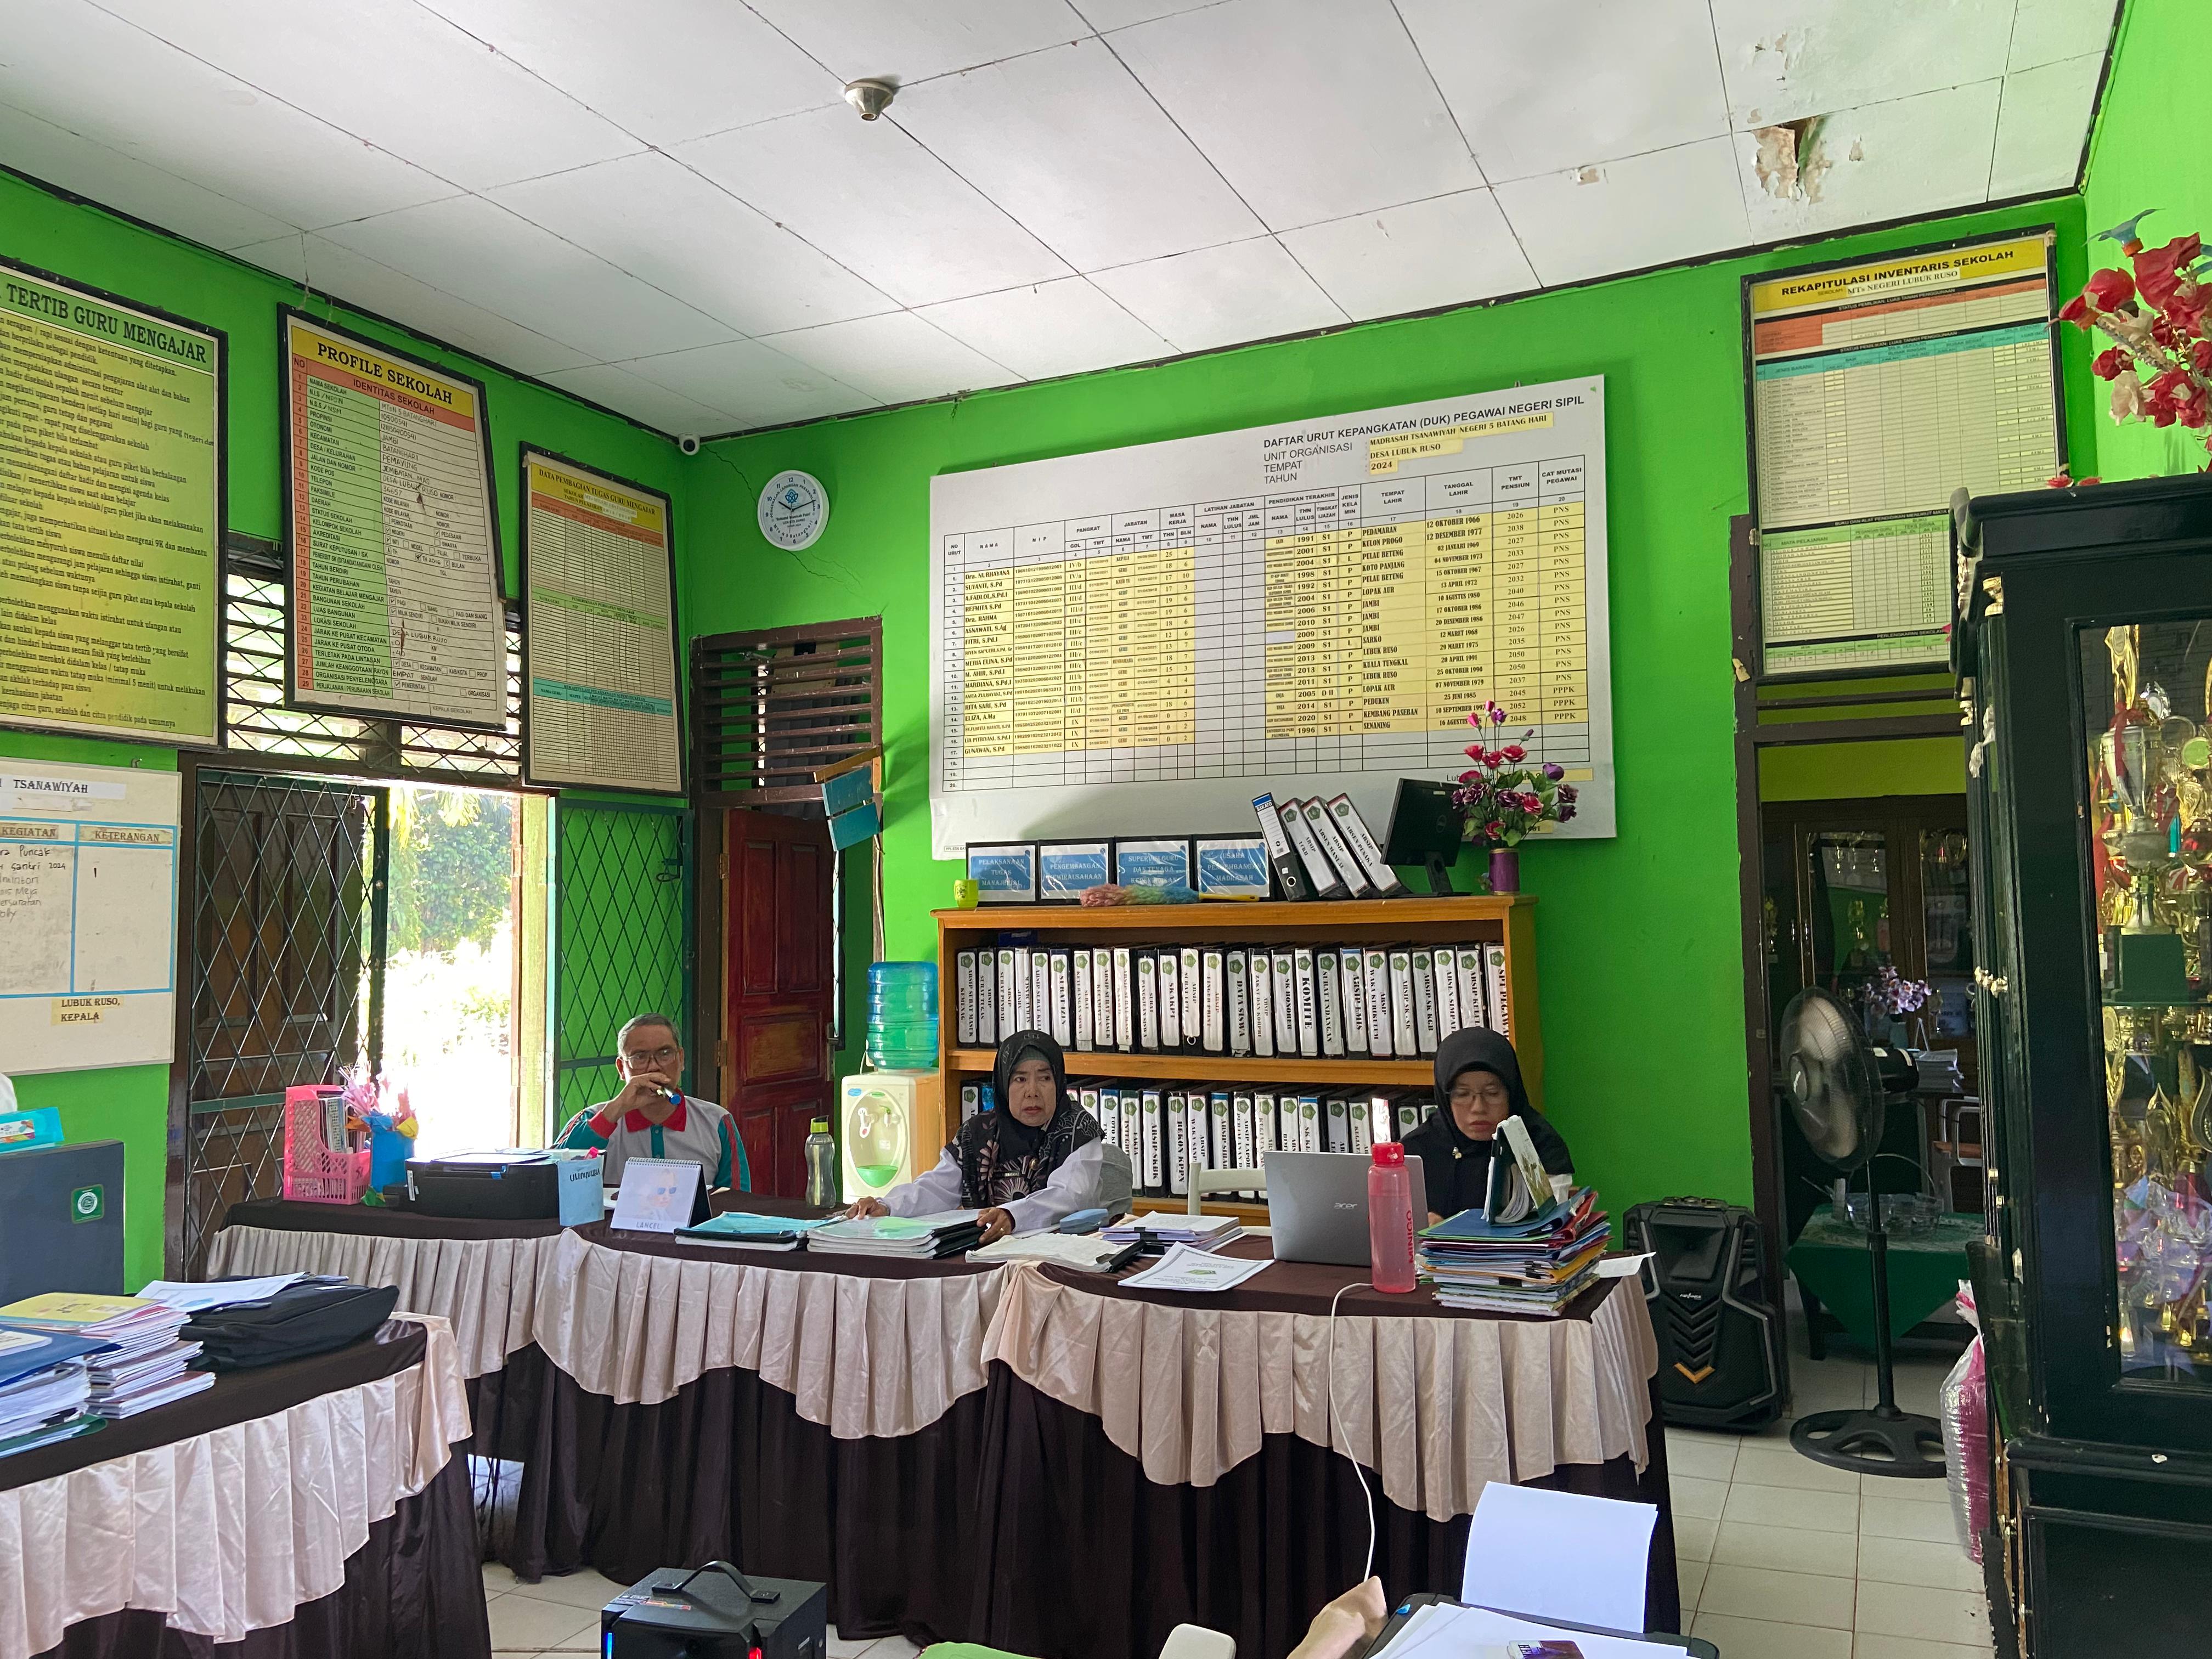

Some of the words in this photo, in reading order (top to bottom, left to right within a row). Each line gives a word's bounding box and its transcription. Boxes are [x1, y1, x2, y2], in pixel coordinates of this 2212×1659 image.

[1782, 274, 1870, 296] REKAPITULASI
[1875, 261, 1949, 280] INVENTARIS
[1954, 251, 2013, 267] SEKOLAH
[1848, 286, 1865, 295] MTs
[1867, 279, 1900, 291] NEGERI
[1903, 274, 1931, 285] LUBUK
[1934, 270, 1957, 280] RUSO
[7, 283, 68, 319] TERTIB
[75, 307, 117, 334] GURU
[123, 321, 206, 363] MENGAJAR
[40, 329, 52, 340] rapi
[75, 338, 96, 352] dengan
[98, 346, 127, 362] ketentuan
[130, 356, 143, 368] yang
[145, 360, 177, 376] ditetapkan.
[318, 342, 382, 377] PROFILE
[388, 369, 452, 404] SEKOLAH
[309, 378, 323, 388] NAMA
[324, 382, 347, 396] SEKOLAH
[353, 379, 395, 400] IDENTITAS
[398, 396, 435, 415] SEKOLAH
[310, 421, 332, 433] OTONOMI
[1264, 435, 1304, 448] DAFTAR
[1307, 431, 1335, 442] URUT
[1338, 419, 1417, 438] KEPANGKATAN
[1420, 415, 1450, 428] (DUK)
[1454, 407, 1505, 422] PEGAWAI
[1509, 400, 1551, 415] NEGERI
[1555, 396, 1584, 408] SIPIL
[311, 432, 339, 446] KECAMATAN
[1264, 451, 1286, 461] UNIT
[1290, 442, 1352, 459] ORGANISASI
[1370, 435, 1409, 446] MADRASAH
[1411, 428, 1456, 441] TSANAWIYAH
[1460, 424, 1486, 433] NEGERI
[1497, 419, 1526, 428] BATANG
[1528, 415, 1547, 424] HARI
[311, 443, 323, 452] DESA
[326, 448, 356, 461] KELURAHAN
[1264, 461, 1302, 473] TEMPAT
[1392, 448, 1417, 456] LUBUK
[1420, 444, 1441, 452] RUSO
[383, 455, 417, 471] PEMAYUNG
[382, 465, 412, 478] JEMBATAN
[417, 476, 430, 485] MAS
[1265, 473, 1297, 484] TAHUN
[1372, 461, 1392, 470] 2024
[1557, 467, 1582, 476] MUTASI
[1547, 476, 1577, 484] PEGAWAI
[539, 469, 554, 481] DATA
[556, 475, 590, 493] PEMBAGIAN
[592, 488, 609, 499] TUGAS
[611, 495, 625, 505] GURU
[627, 499, 655, 515] MENGAJAR
[1269, 496, 1304, 504] PENDIDIKAN
[1305, 493, 1335, 501] TERAKHIR
[1363, 527, 1397, 536] PEDAMARAN
[1435, 518, 1464, 527] OKTOBER
[313, 529, 340, 541] AKREDITASI
[127, 535, 154, 546] mengenai
[155, 539, 163, 548] 9K
[166, 541, 175, 551] dan
[178, 544, 207, 556] membantu
[1362, 539, 1380, 548] KULON
[1382, 537, 1402, 545] PROGO
[978, 570, 1010, 578] NURHAYANA
[313, 584, 335, 594] KEGIATAN
[337, 589, 357, 597] BELAJAR
[359, 593, 384, 602] MENGAJAR
[328, 608, 355, 618] BANGUNAN
[357, 634, 387, 644] KECAMATAN
[393, 670, 414, 679] EMPAT
[138, 681, 156, 690] menit)
[176, 686, 205, 695] melakukan
[1392, 708, 1418, 716] PASEBAN
[13, 780, 88, 793] TSANAWIYAH
[1256, 802, 1272, 811] SAKATO
[2, 827, 57, 837] KEGIATAN
[95, 831, 160, 842] KETERANGAN
[20, 845, 50, 857] Puncak
[61, 998, 93, 1008] LUBUK
[95, 997, 120, 1007] RUSO,
[1302, 977, 1312, 1029] KOMITE
[61, 1012, 99, 1022] KEPALA
